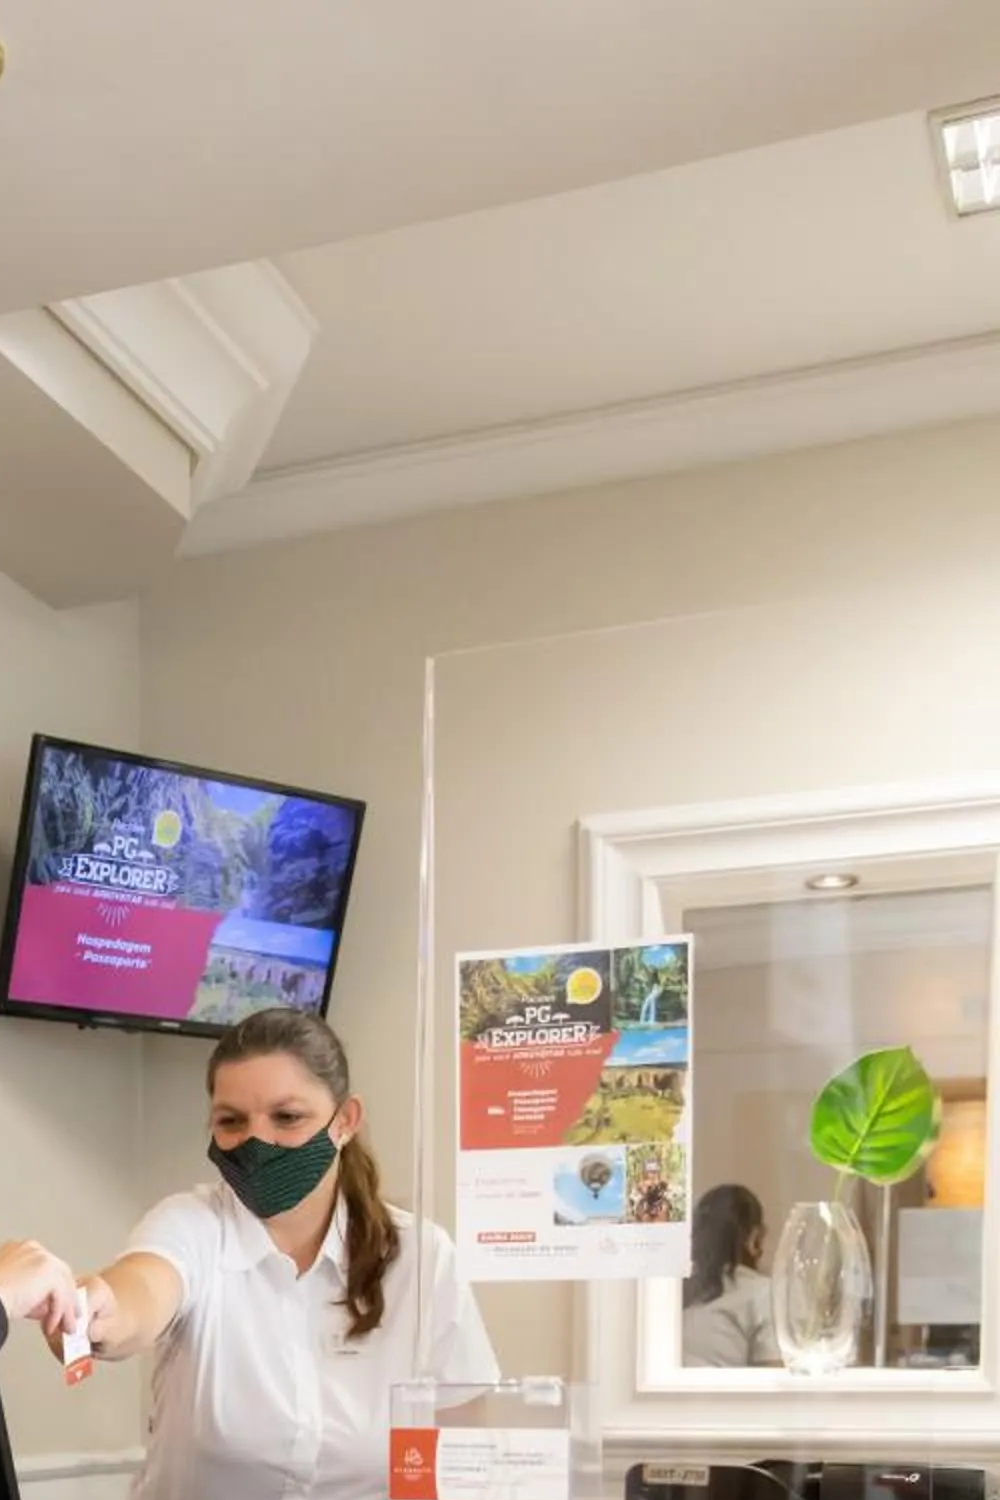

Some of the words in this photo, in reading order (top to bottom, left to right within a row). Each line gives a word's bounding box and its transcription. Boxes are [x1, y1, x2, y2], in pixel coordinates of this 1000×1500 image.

[111, 835, 139, 859] PG
[74, 857, 167, 892] EXPLORER
[525, 1005, 552, 1025] PG
[491, 1025, 587, 1047] EXPLORER
